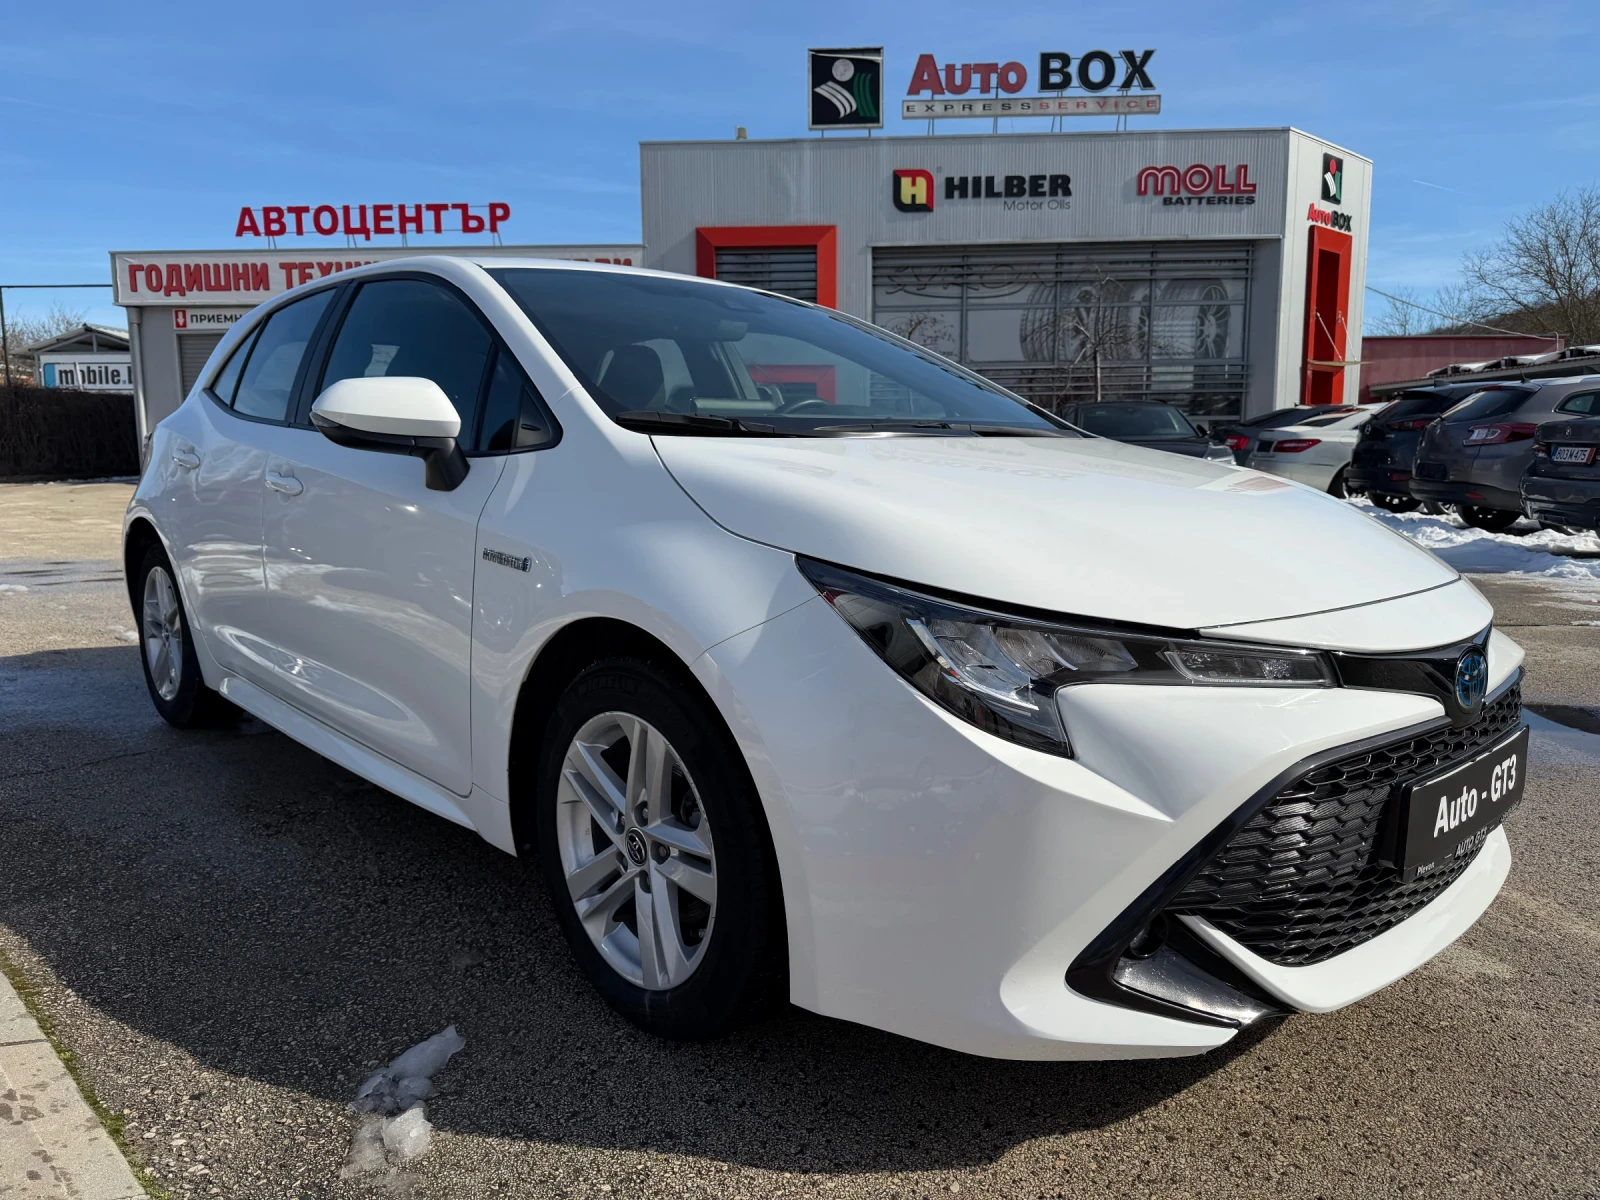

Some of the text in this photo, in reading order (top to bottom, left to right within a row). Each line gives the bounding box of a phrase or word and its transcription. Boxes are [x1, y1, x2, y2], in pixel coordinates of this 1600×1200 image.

[1038, 49, 1156, 93] BOX
[944, 174, 1072, 200] HILBER
[1137, 163, 1257, 197] MOLL
[1003, 197, 1071, 212] Motor Oils
[1163, 195, 1256, 207] BATTERIES
[235, 202, 511, 241] АВТОЦЕНТЪР
[1331, 210, 1353, 233] BOX
[128, 263, 270, 297] ГОДИШНИ
[1433, 785, 1478, 838] Auto
[1490, 753, 1517, 802] GT3
[1454, 835, 1475, 857] AUTO
